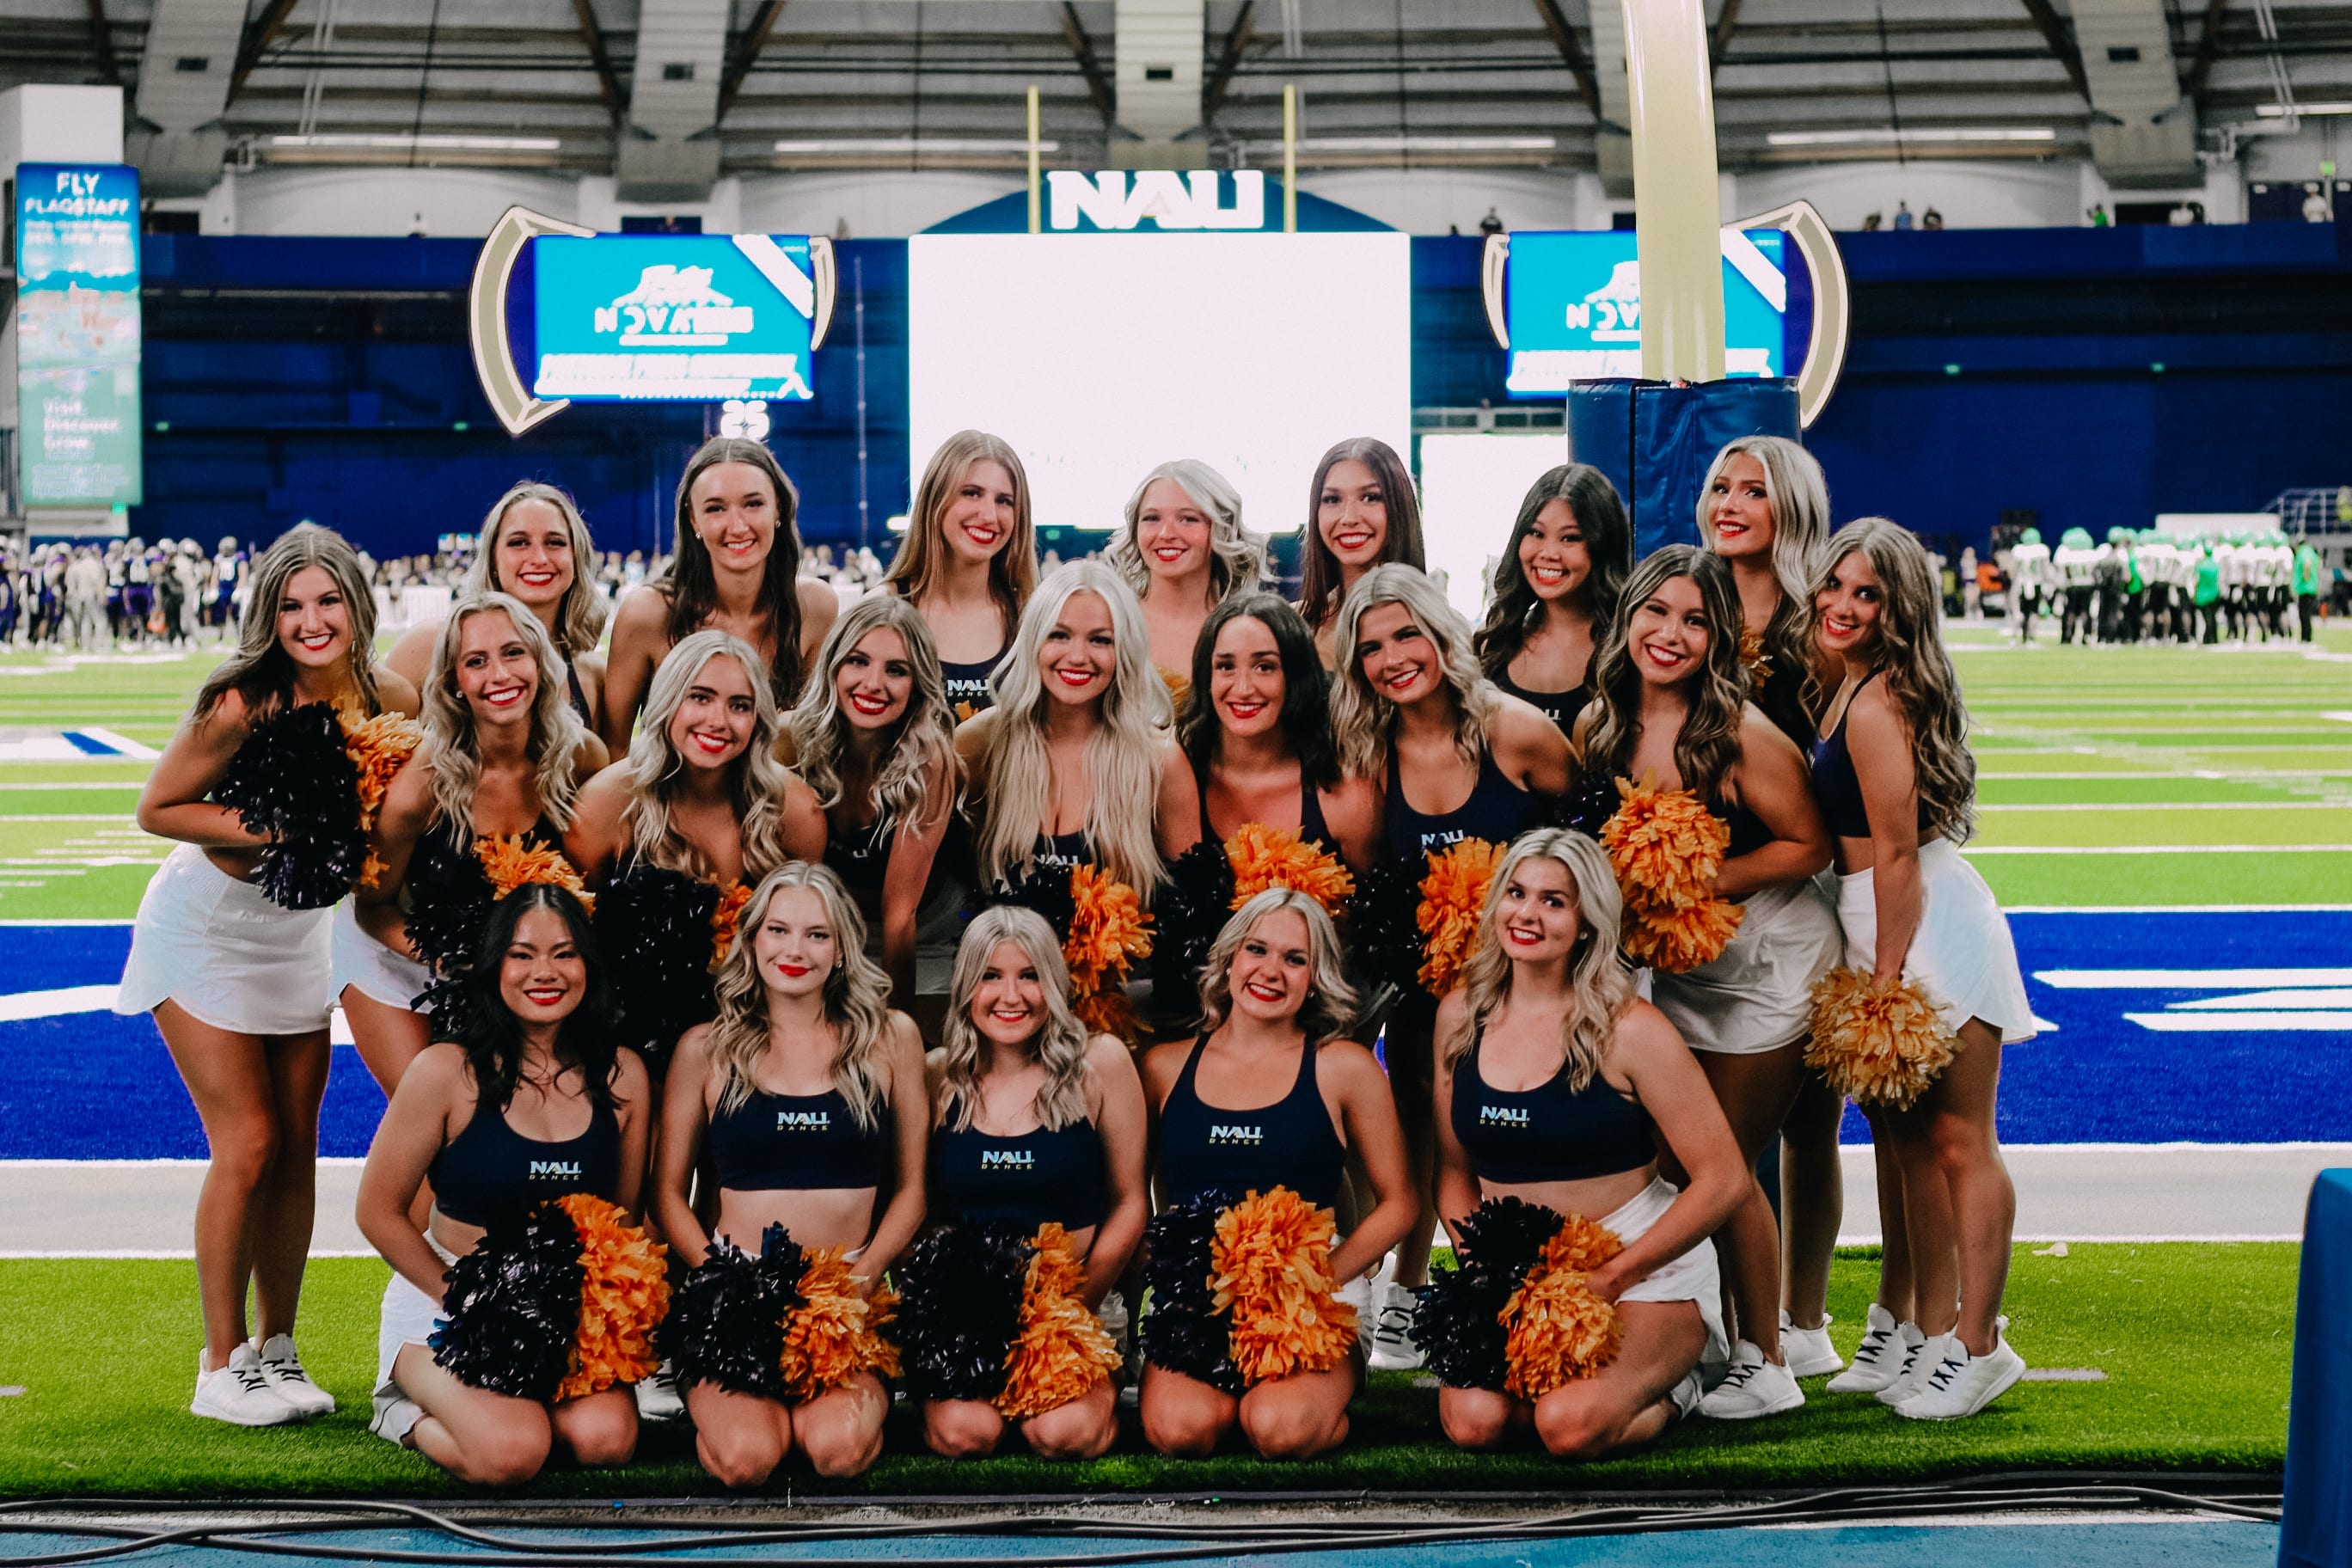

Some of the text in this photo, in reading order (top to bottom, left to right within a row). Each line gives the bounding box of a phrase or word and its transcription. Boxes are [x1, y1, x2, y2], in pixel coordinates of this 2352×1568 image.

[57, 172, 100, 196] FLY
[25, 197, 130, 217] FLAGSTAFF
[1046, 169, 1265, 230] NAU
[1421, 830, 1464, 846] NAU
[777, 1112, 829, 1124] NAU
[1480, 1106, 1528, 1122] NAU
[1479, 1118, 1528, 1128] DANCE
[1210, 1125, 1261, 1139] NAU
[982, 1150, 1032, 1164] NAU
[530, 1161, 579, 1174] NAU
